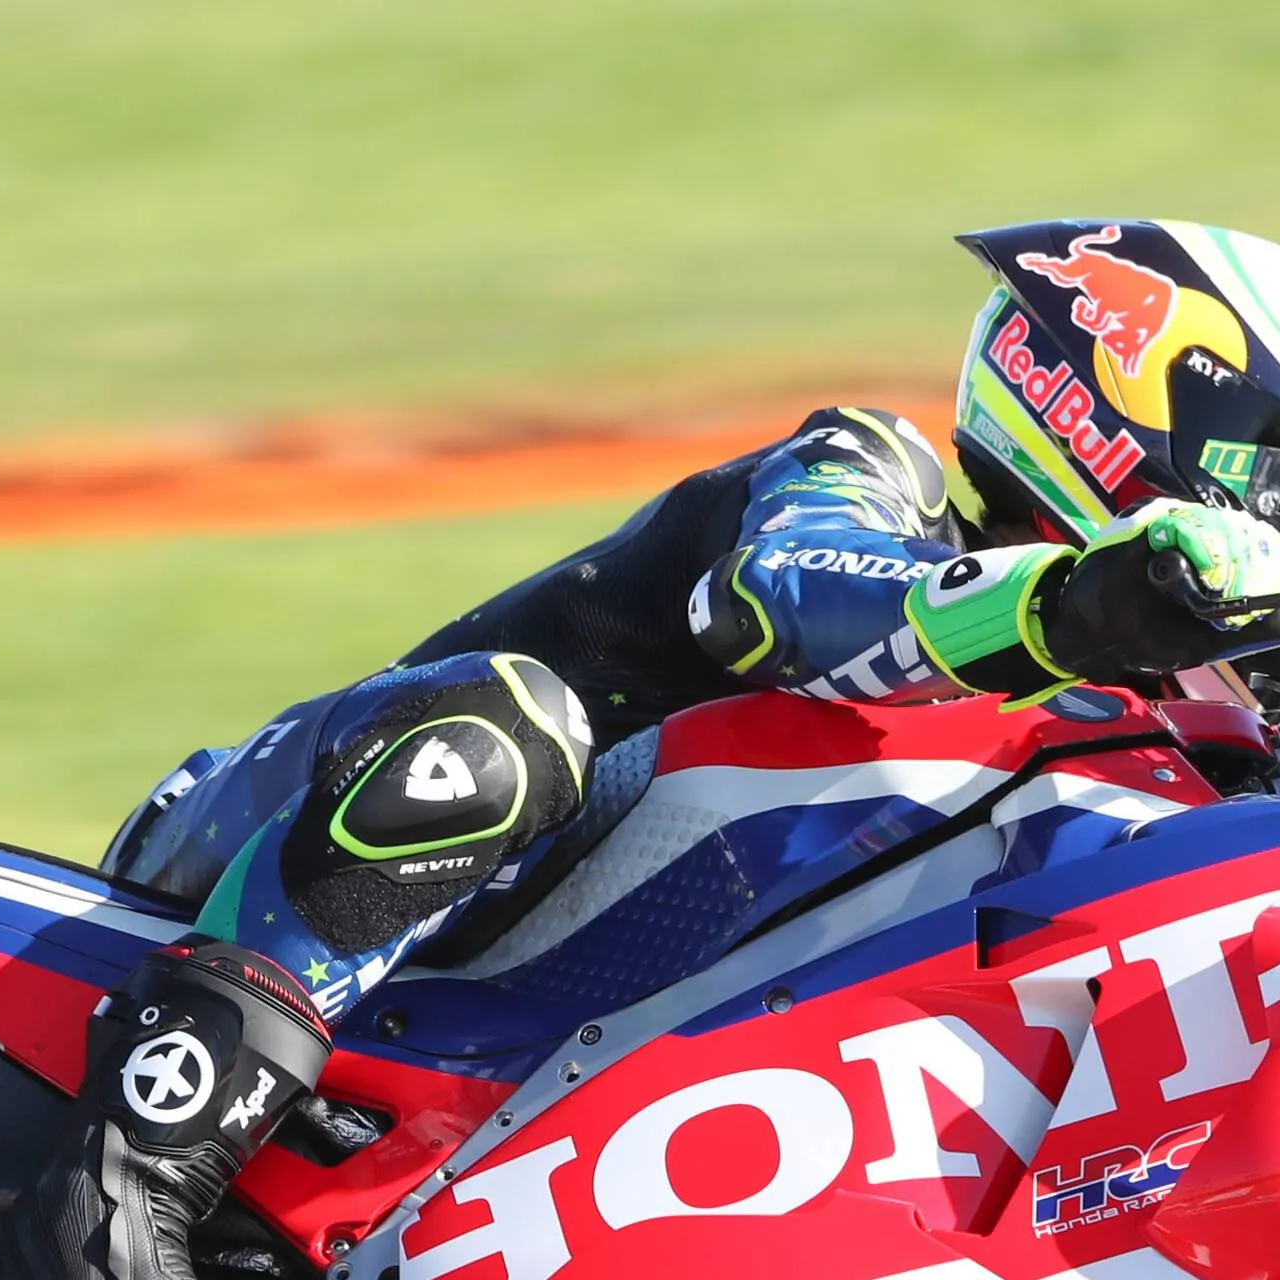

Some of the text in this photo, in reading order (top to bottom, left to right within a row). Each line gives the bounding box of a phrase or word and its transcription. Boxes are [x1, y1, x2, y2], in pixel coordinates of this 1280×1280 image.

[1186, 350, 1233, 387] KYT
[988, 310, 1074, 413] Red
[1043, 376, 1147, 494] Bull
[758, 548, 936, 583] HONDA
[398, 855, 475, 876] REV'IT!
[1031, 1119, 1212, 1228] HRC
[1033, 1203, 1120, 1239] Honda
